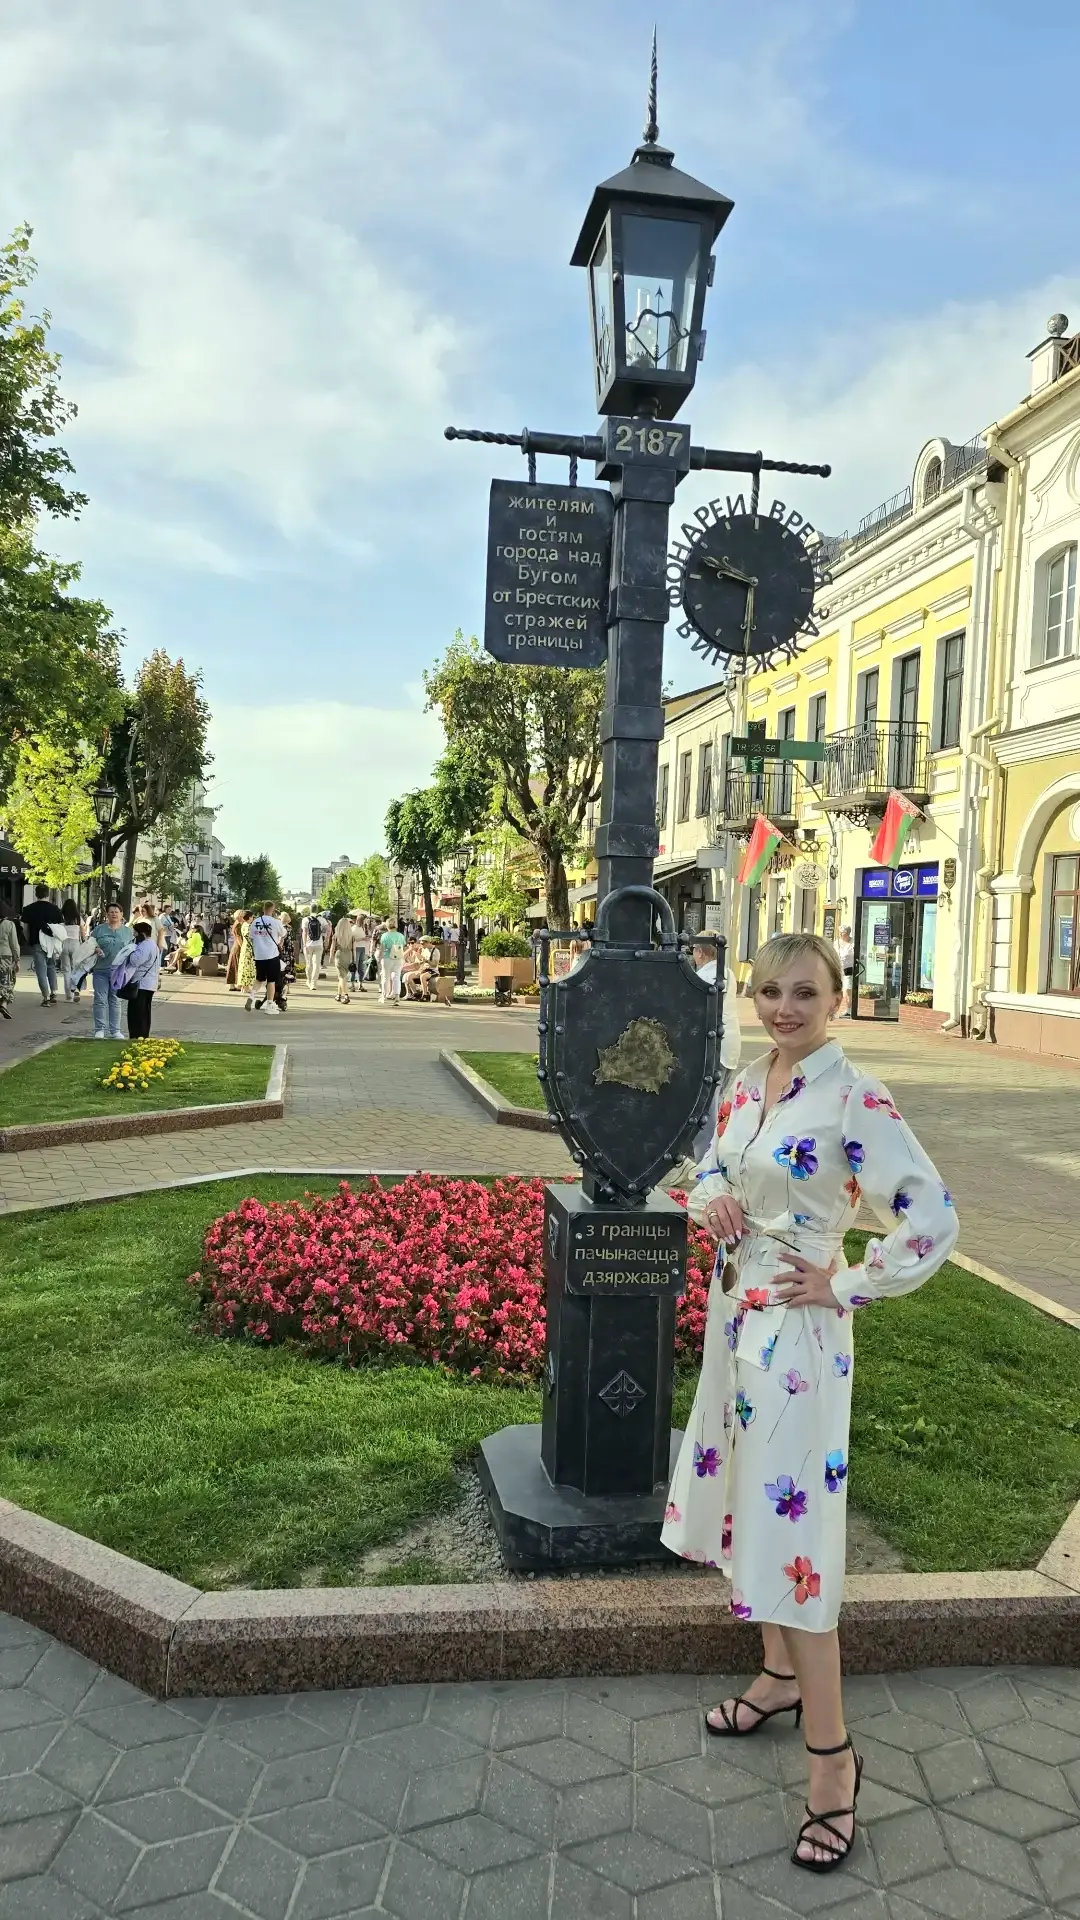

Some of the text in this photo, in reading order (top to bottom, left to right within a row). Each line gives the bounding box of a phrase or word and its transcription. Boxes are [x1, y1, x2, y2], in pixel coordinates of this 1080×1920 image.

[615, 424, 684, 457] 2187
[508, 496, 594, 514] жителям
[546, 515, 557, 527] и
[519, 527, 583, 544] гостям
[769, 499, 833, 586] ВРЕМЯ
[496, 545, 601, 567] города над
[518, 564, 577, 585] Бугом
[492, 588, 601, 610] от Брестских
[504, 613, 587, 630] стражей
[507, 633, 583, 651] границы
[675, 602, 831, 675] ЗАЖЖЕНИЯ
[601, 1224, 670, 1241] граніцы
[574, 1247, 679, 1265] пачынаецца
[582, 1270, 670, 1288] дзяржава
